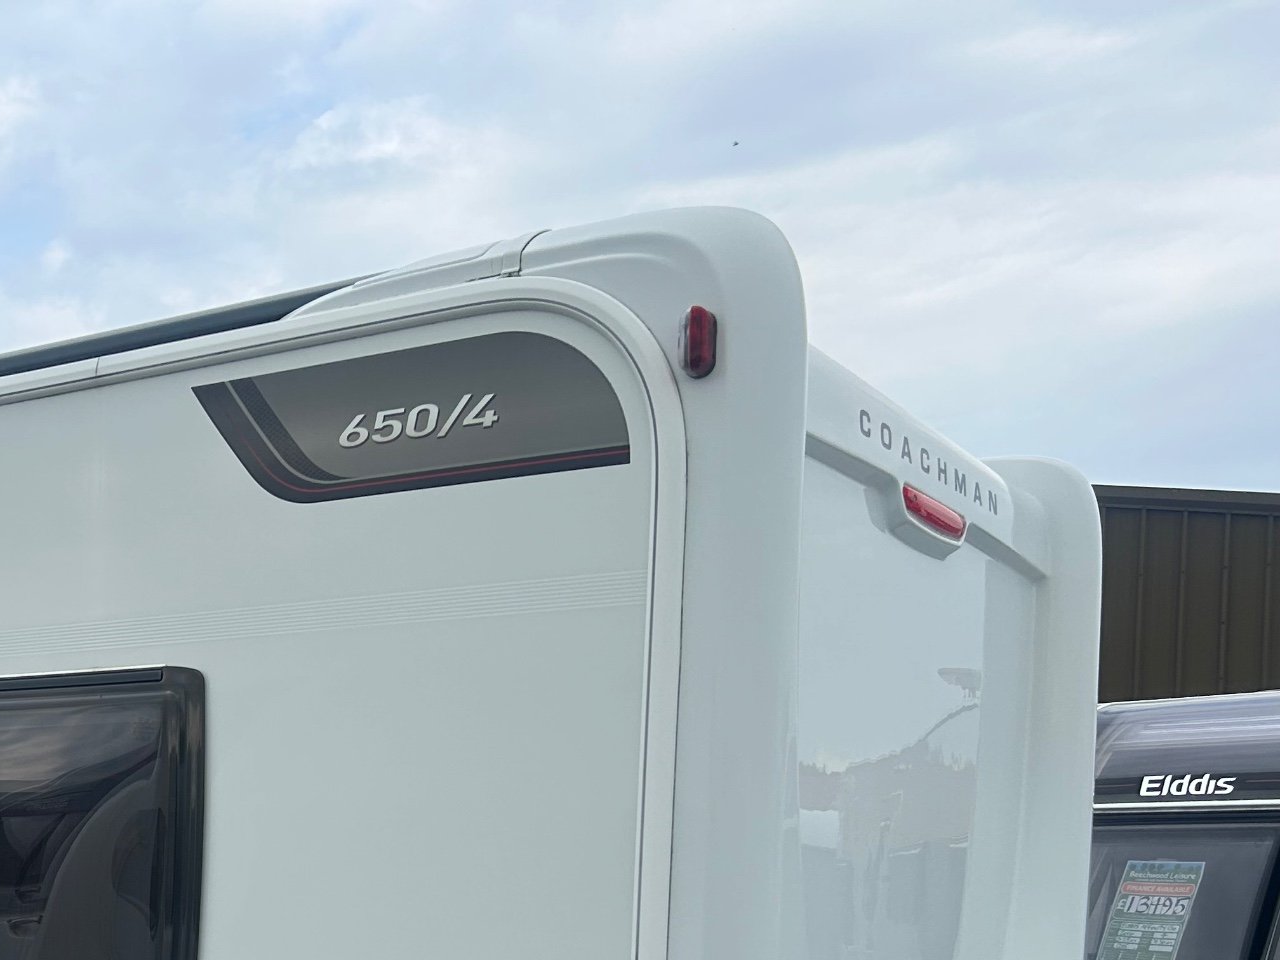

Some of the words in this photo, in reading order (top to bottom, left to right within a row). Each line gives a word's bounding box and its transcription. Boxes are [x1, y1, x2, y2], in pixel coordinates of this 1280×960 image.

[338, 393, 499, 448] 650/4
[859, 409, 998, 516] COACHMAN
[1140, 773, 1237, 796] Elddis
[1129, 870, 1169, 879] Beechwood
[1169, 872, 1197, 880] Leisure
